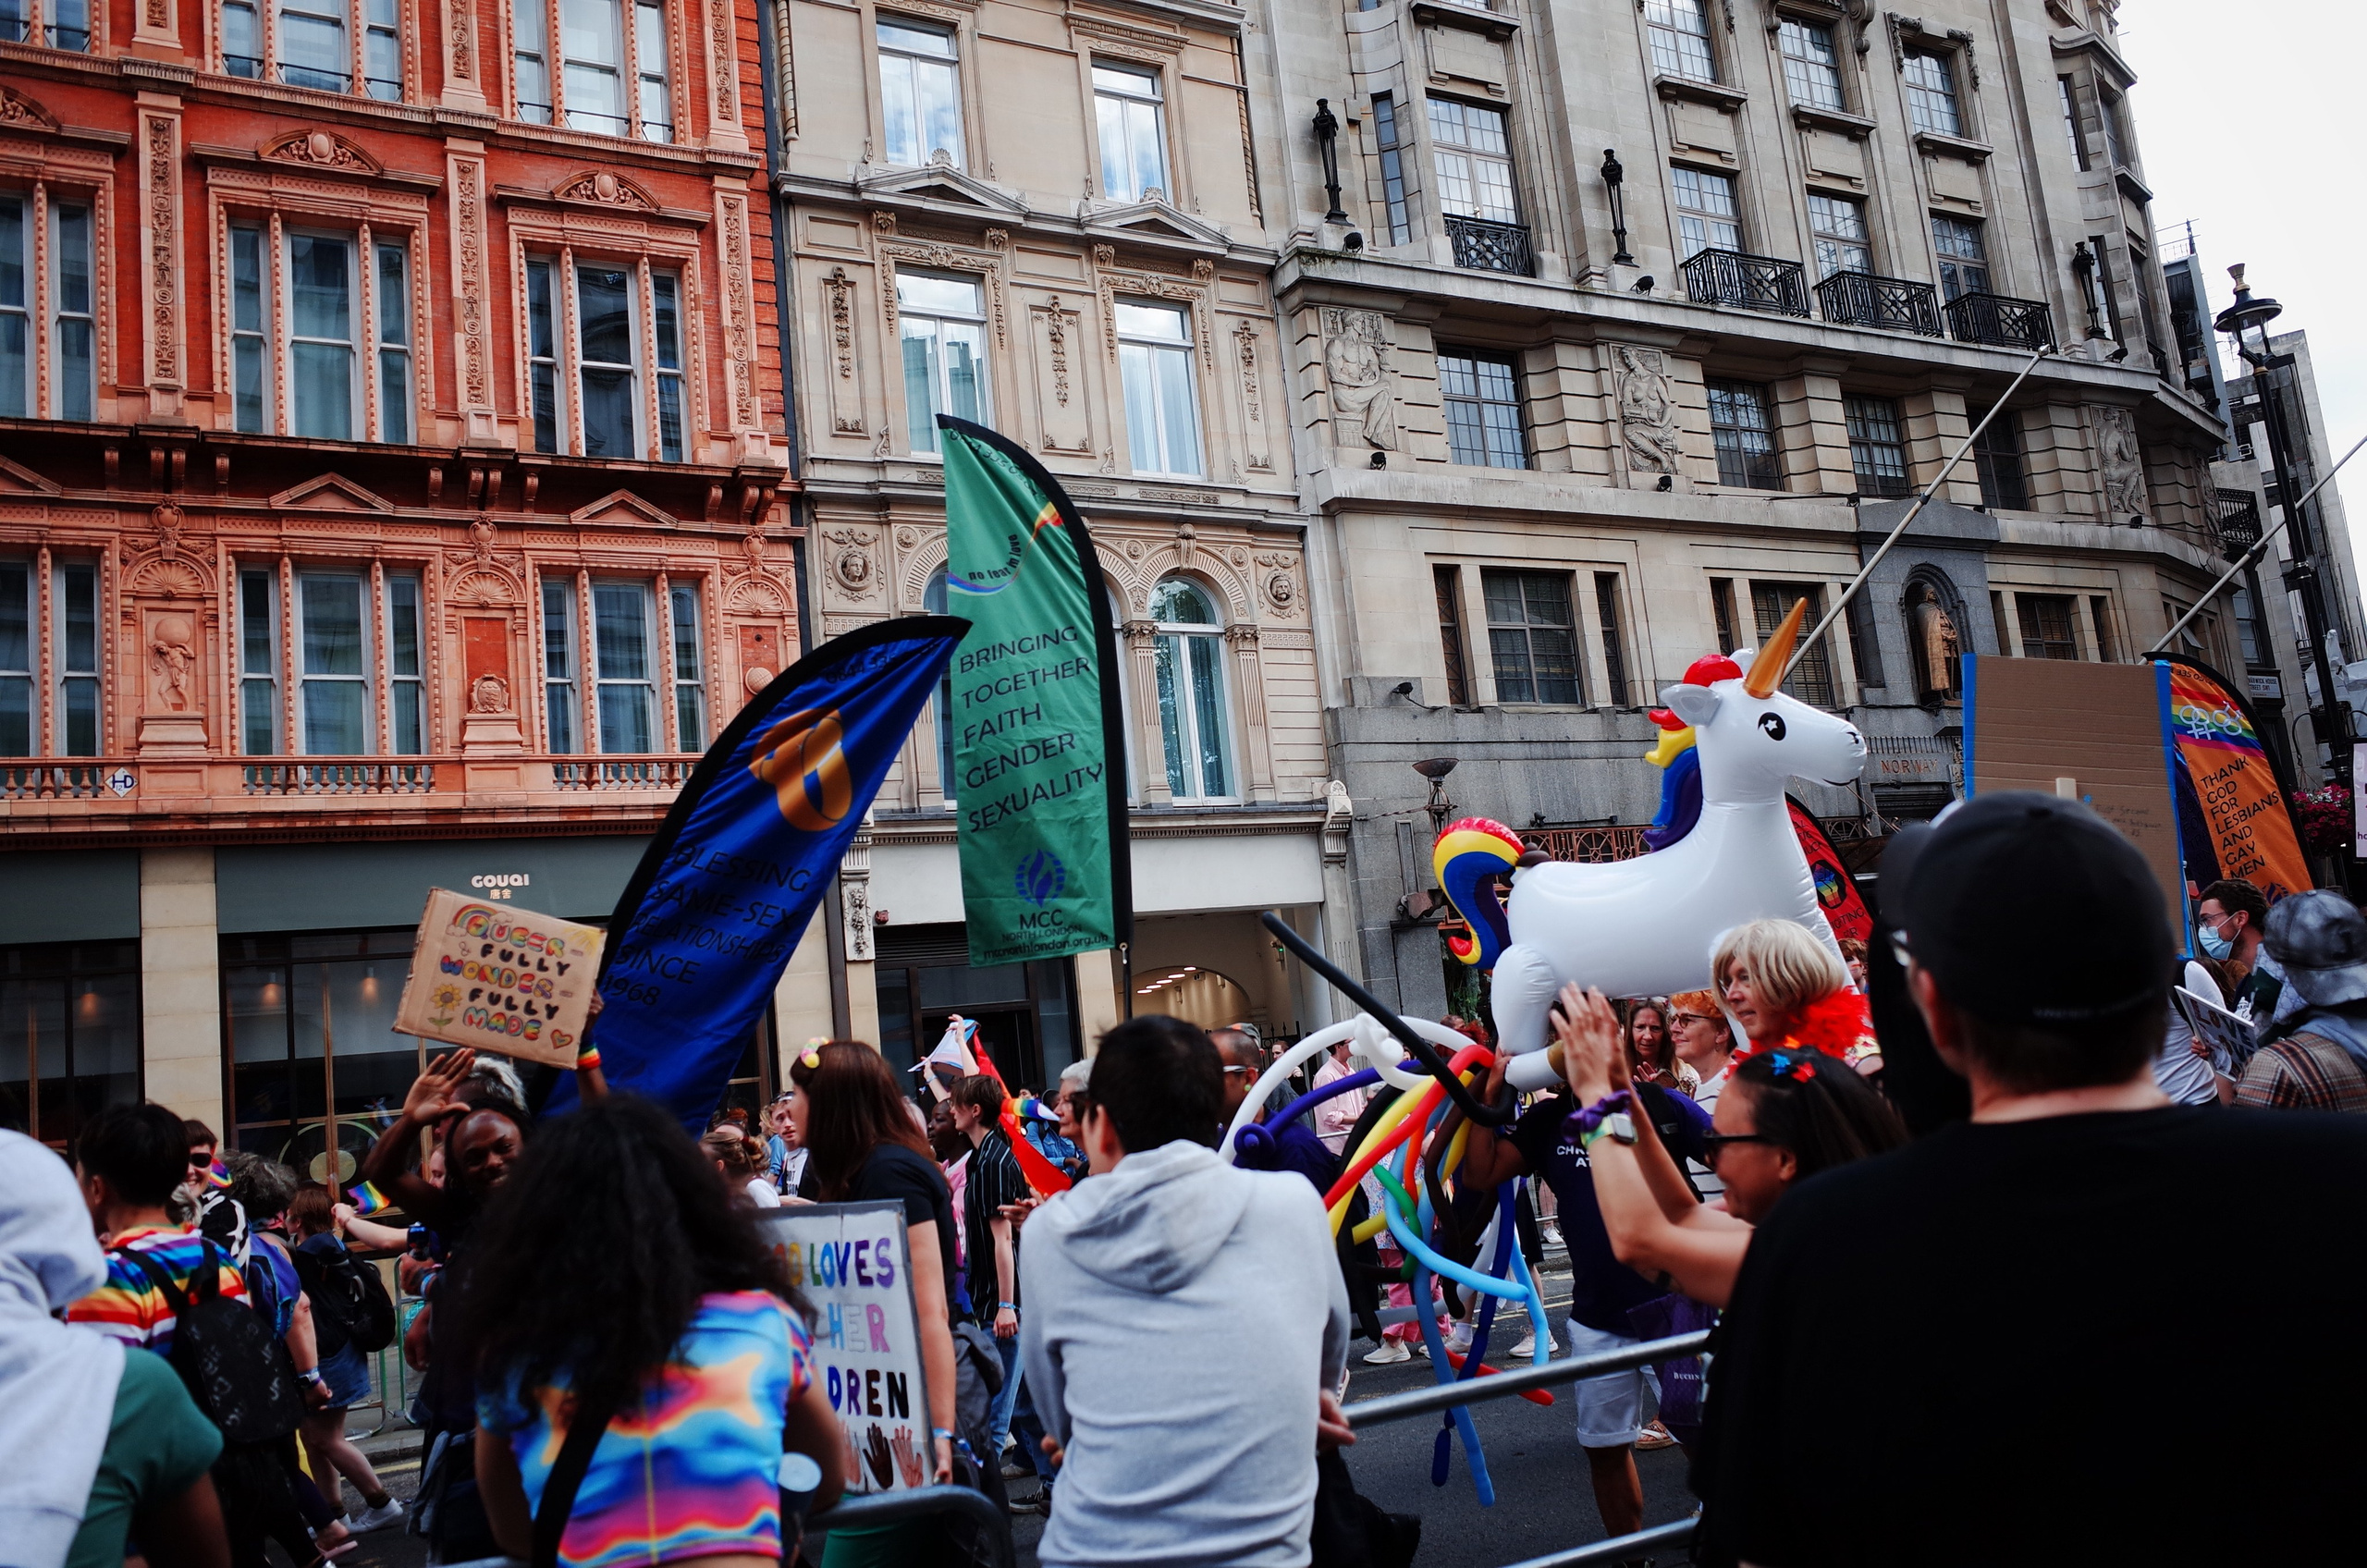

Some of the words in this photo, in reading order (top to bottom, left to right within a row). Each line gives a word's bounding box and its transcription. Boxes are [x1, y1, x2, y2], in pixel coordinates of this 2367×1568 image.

[968, 571, 985, 581] no
[987, 566, 1012, 580] fear
[1008, 533, 1022, 557] love
[960, 626, 1078, 674] BRINGING
[961, 656, 1092, 709] TOGETHER
[964, 703, 1042, 749] FAITH
[966, 732, 1076, 790] GENDER
[1881, 758, 1938, 774] NORWAY
[2201, 756, 2250, 789] THANK
[968, 762, 1103, 833] SEXUALITY
[2207, 780, 2238, 804] GOD
[2210, 797, 2239, 820] FOR
[2214, 790, 2280, 835] LESBIANS
[2223, 826, 2252, 851] AND
[2226, 841, 2255, 866] GAY
[471, 874, 530, 888] GOUQI
[673, 843, 811, 892] BLESSING
[2229, 855, 2265, 879] MEN
[651, 879, 799, 931] SAME-SEX
[1019, 909, 1063, 930] MCC
[632, 912, 785, 963] RELATIONSHIPS
[1001, 931, 1036, 943] NORTH
[1038, 925, 1082, 937] LONDON
[480, 943, 570, 976] FULLY
[615, 945, 701, 985] SINCE
[469, 987, 559, 1020] FULLY
[602, 974, 661, 1006] 1968
[463, 1006, 543, 1041] MADE
[1556, 1145, 1589, 1156] CHR
[809, 1236, 895, 1290] LOVES
